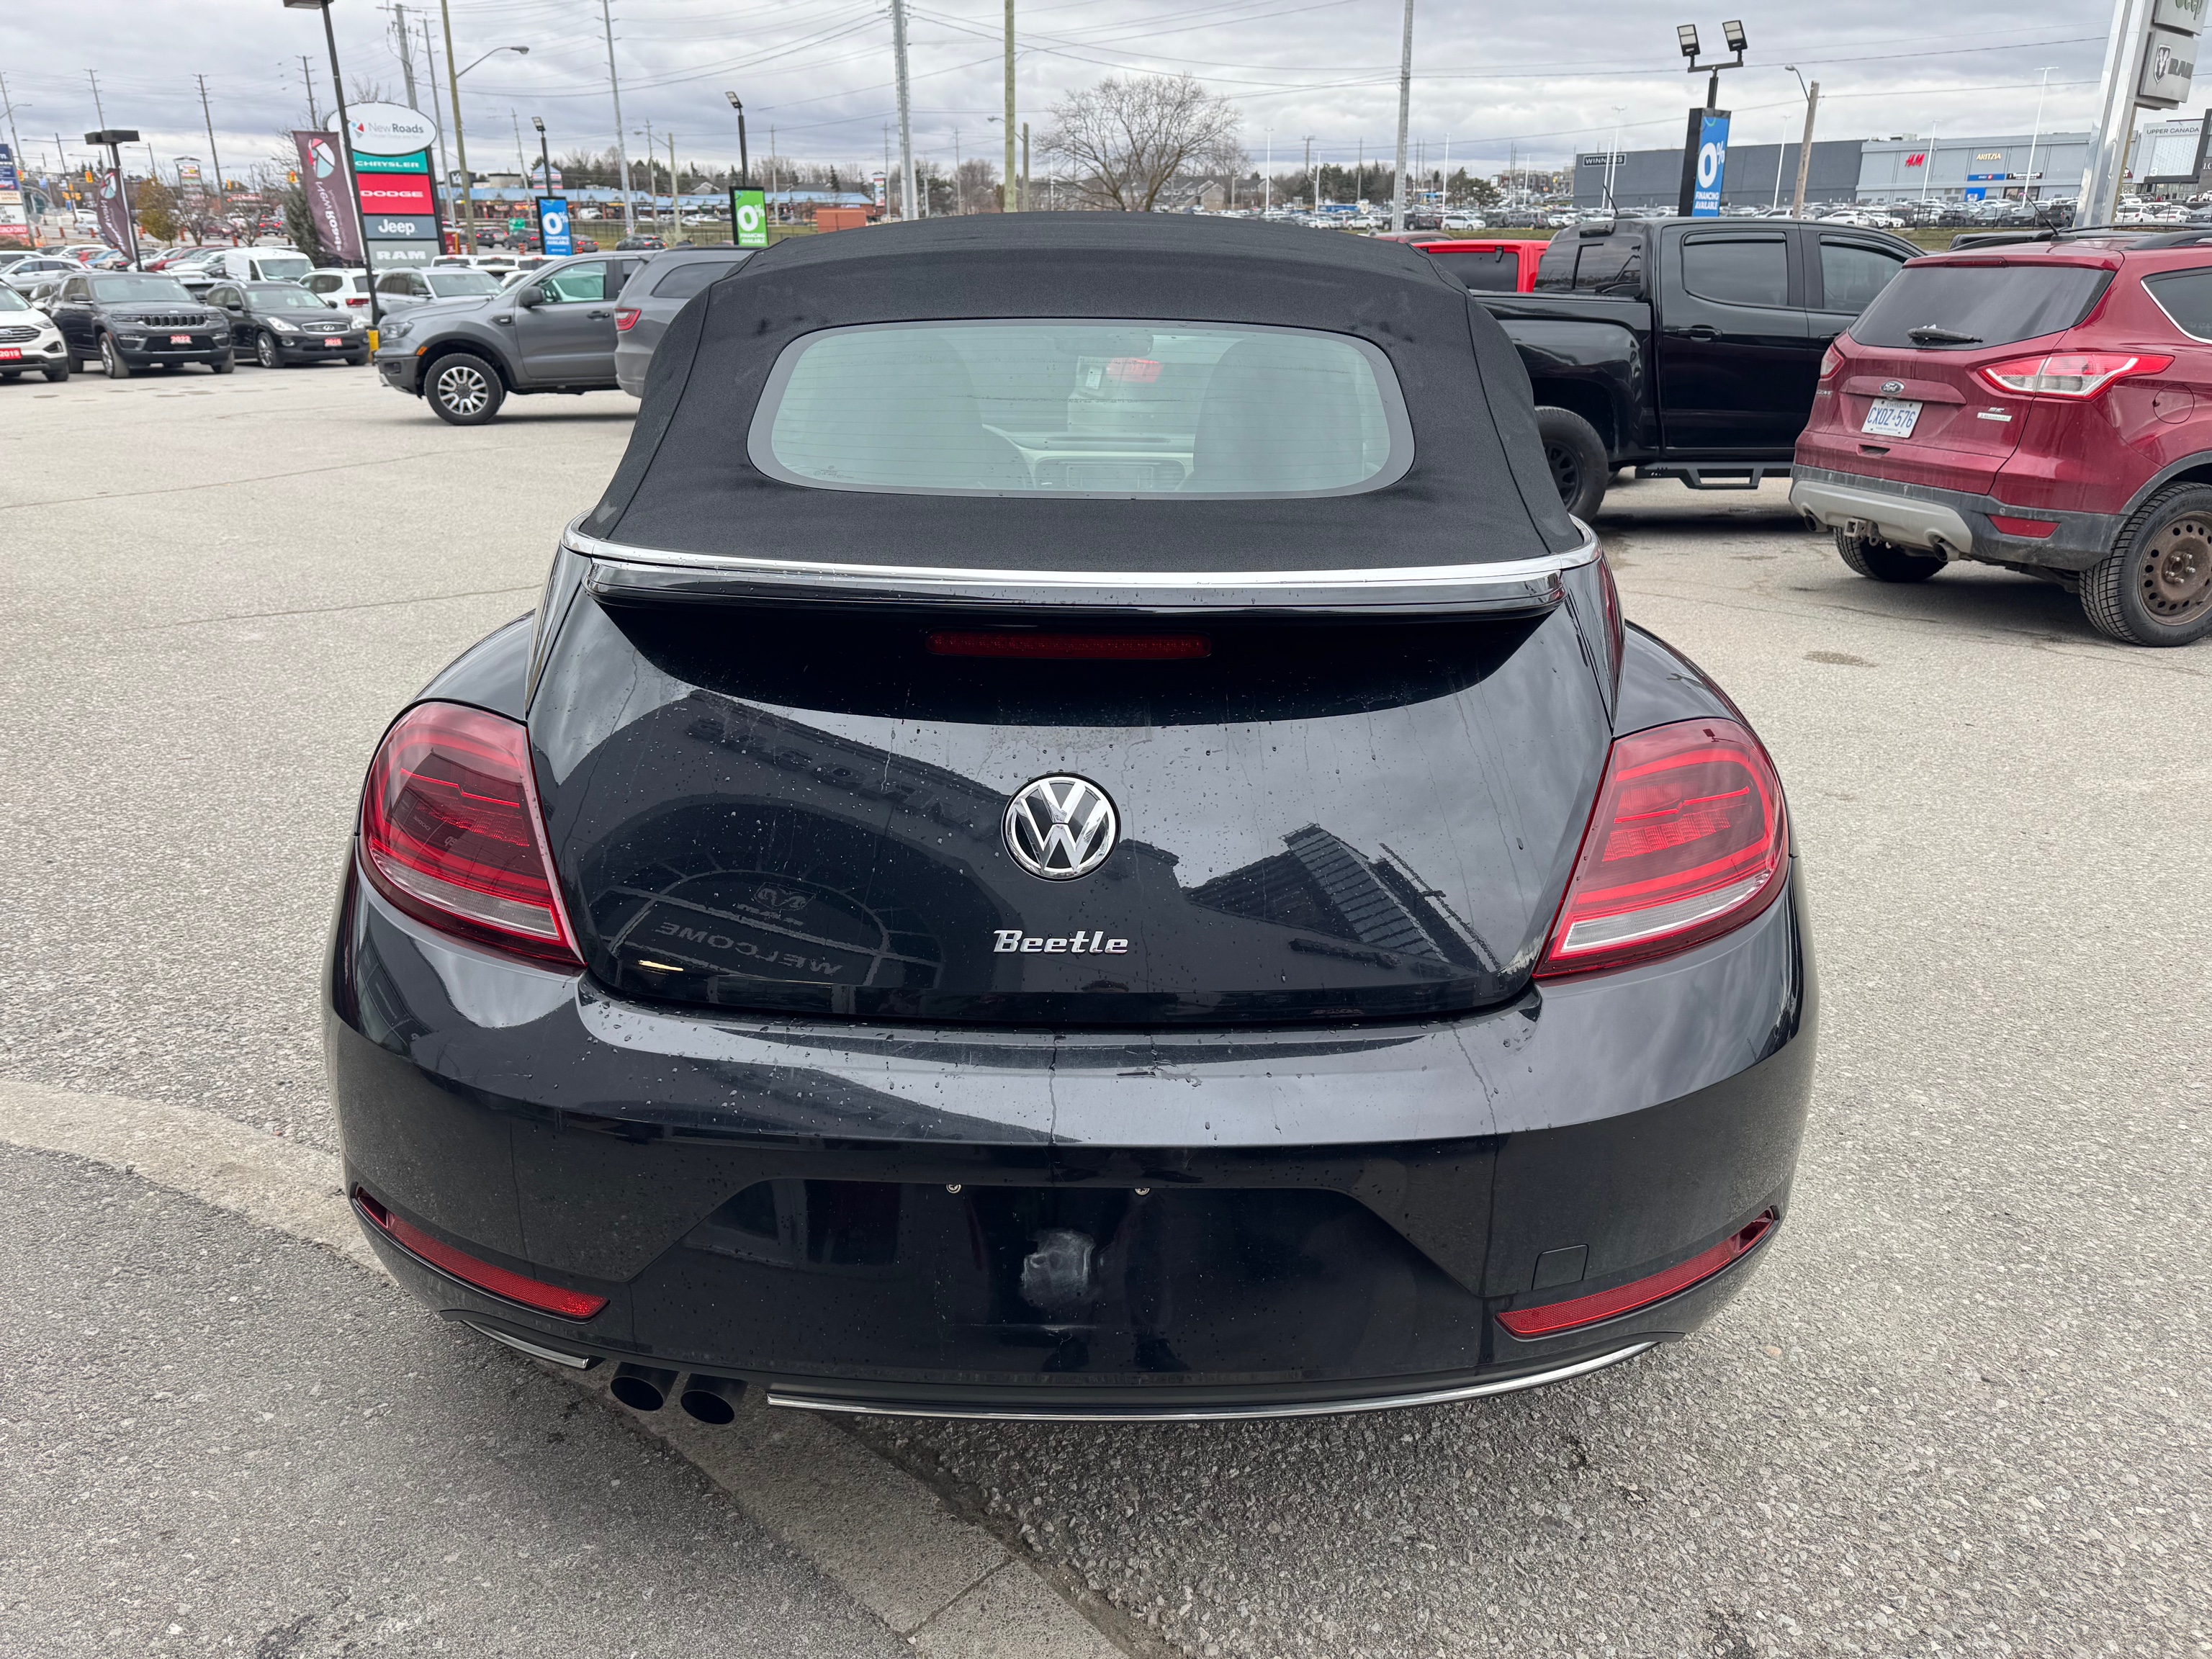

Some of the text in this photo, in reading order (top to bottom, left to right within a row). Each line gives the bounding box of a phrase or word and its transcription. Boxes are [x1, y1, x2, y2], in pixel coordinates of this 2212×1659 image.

[2168, 58, 2194, 80] RAM
[1697, 140, 1725, 189] 0%
[1694, 201, 1718, 210] AVAILABLE
[1695, 191, 1719, 200] FINANCING
[378, 219, 415, 235] Jeep
[542, 211, 569, 235] 0%
[737, 203, 765, 232] 0%
[376, 251, 426, 260] RAM
[1894, 409, 1915, 428] 576
[993, 930, 1128, 954] Beetle
